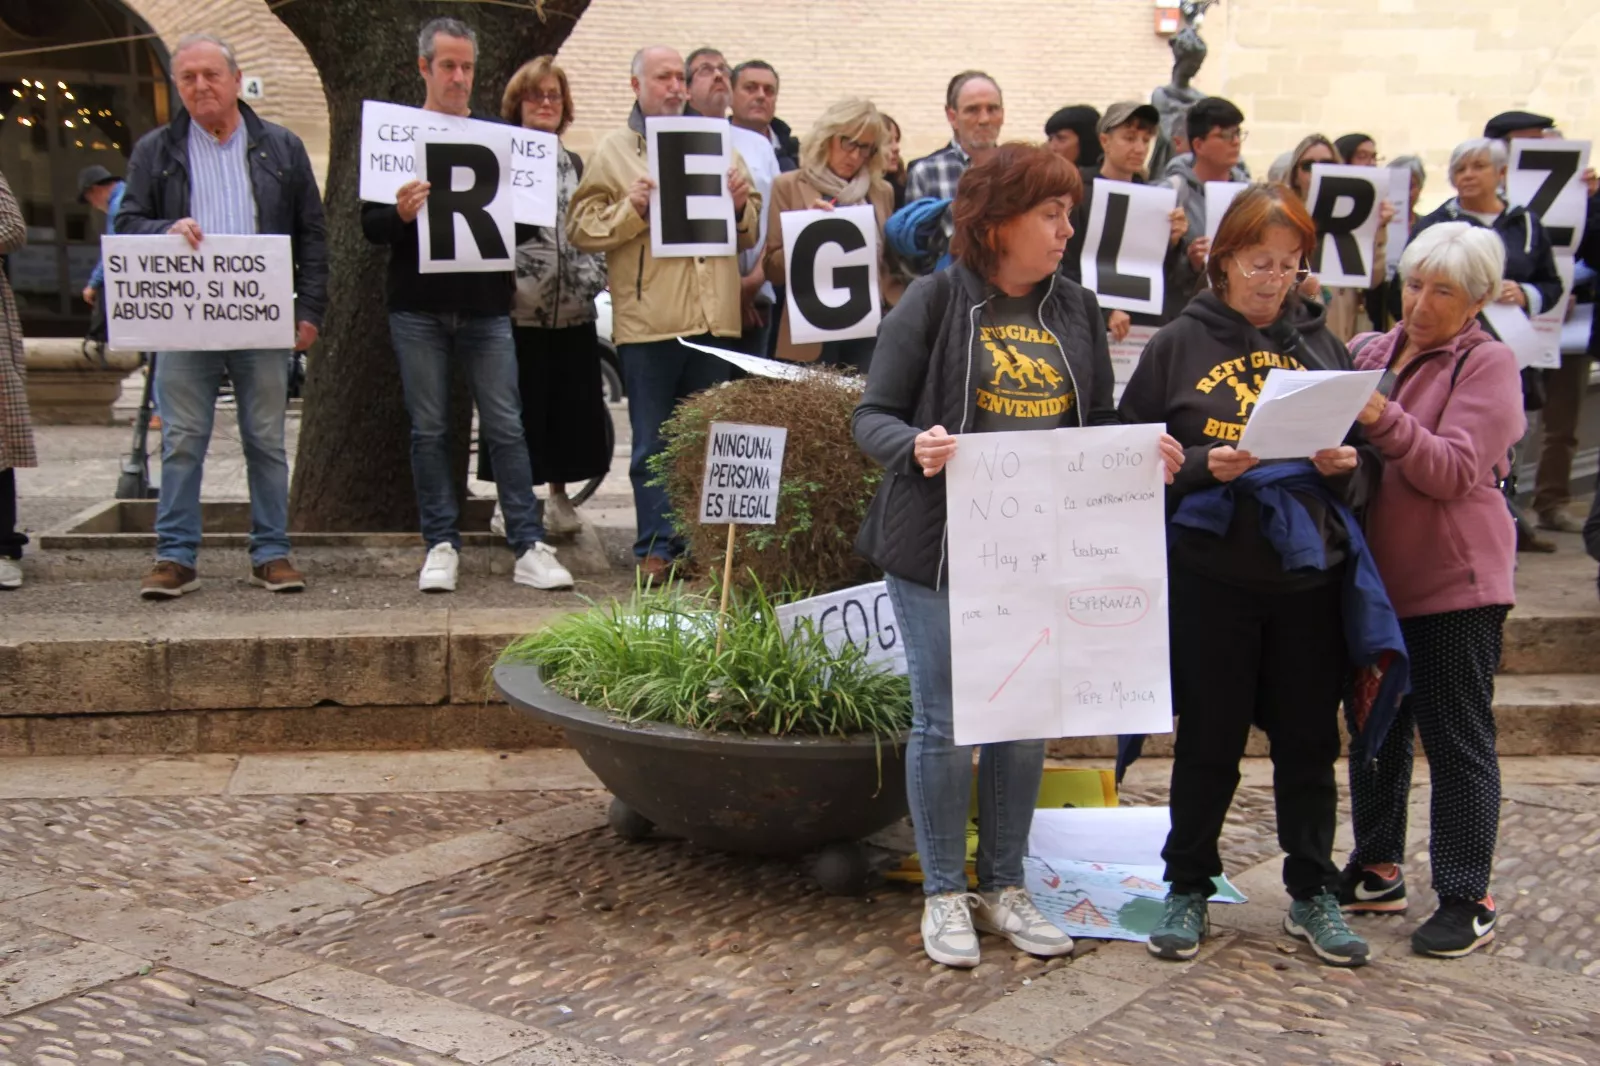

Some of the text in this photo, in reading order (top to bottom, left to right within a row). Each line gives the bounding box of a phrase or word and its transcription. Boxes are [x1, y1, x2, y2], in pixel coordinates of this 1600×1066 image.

[247, 81, 258, 94] 4
[370, 154, 416, 172] MENO
[425, 143, 510, 260] R
[657, 131, 728, 245] E
[1311, 176, 1376, 276] R
[1096, 192, 1151, 301] L
[109, 255, 266, 273] SI VIENEN RICOS
[790, 218, 872, 331] G
[115, 281, 265, 300] TURISMO, SI NO,
[112, 303, 280, 321] ABUSO Y RACISMO
[713, 433, 771, 460] NINGUNA
[972, 441, 1020, 480] NO
[1068, 452, 1084, 472] al
[709, 463, 770, 489] PERSONA
[706, 493, 771, 518] ES ILEGAL
[970, 491, 1018, 520] NO
[978, 543, 1017, 572] Hay
[1069, 596, 1142, 610] ESPERANZA
